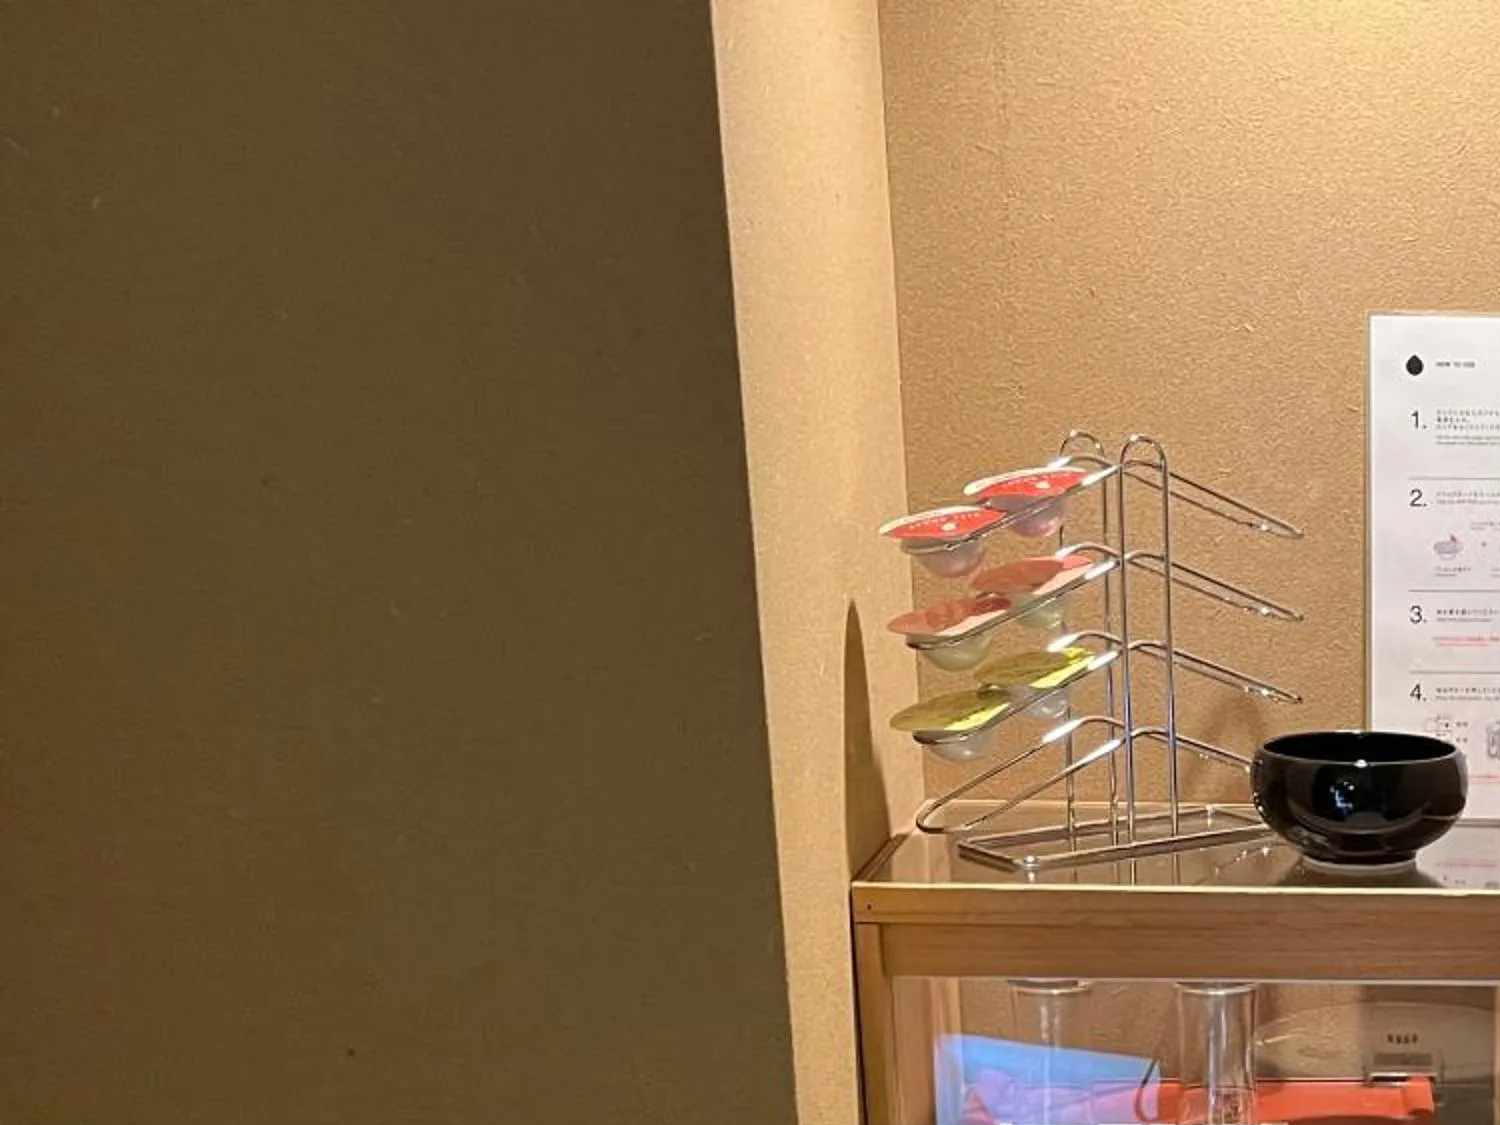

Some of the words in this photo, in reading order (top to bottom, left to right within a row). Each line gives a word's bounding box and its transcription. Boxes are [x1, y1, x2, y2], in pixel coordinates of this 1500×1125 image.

[1410, 410, 1427, 429] 1.
[1409, 488, 1428, 508] 2.
[1409, 605, 1428, 624] 3.
[1409, 683, 1427, 703] 4.
